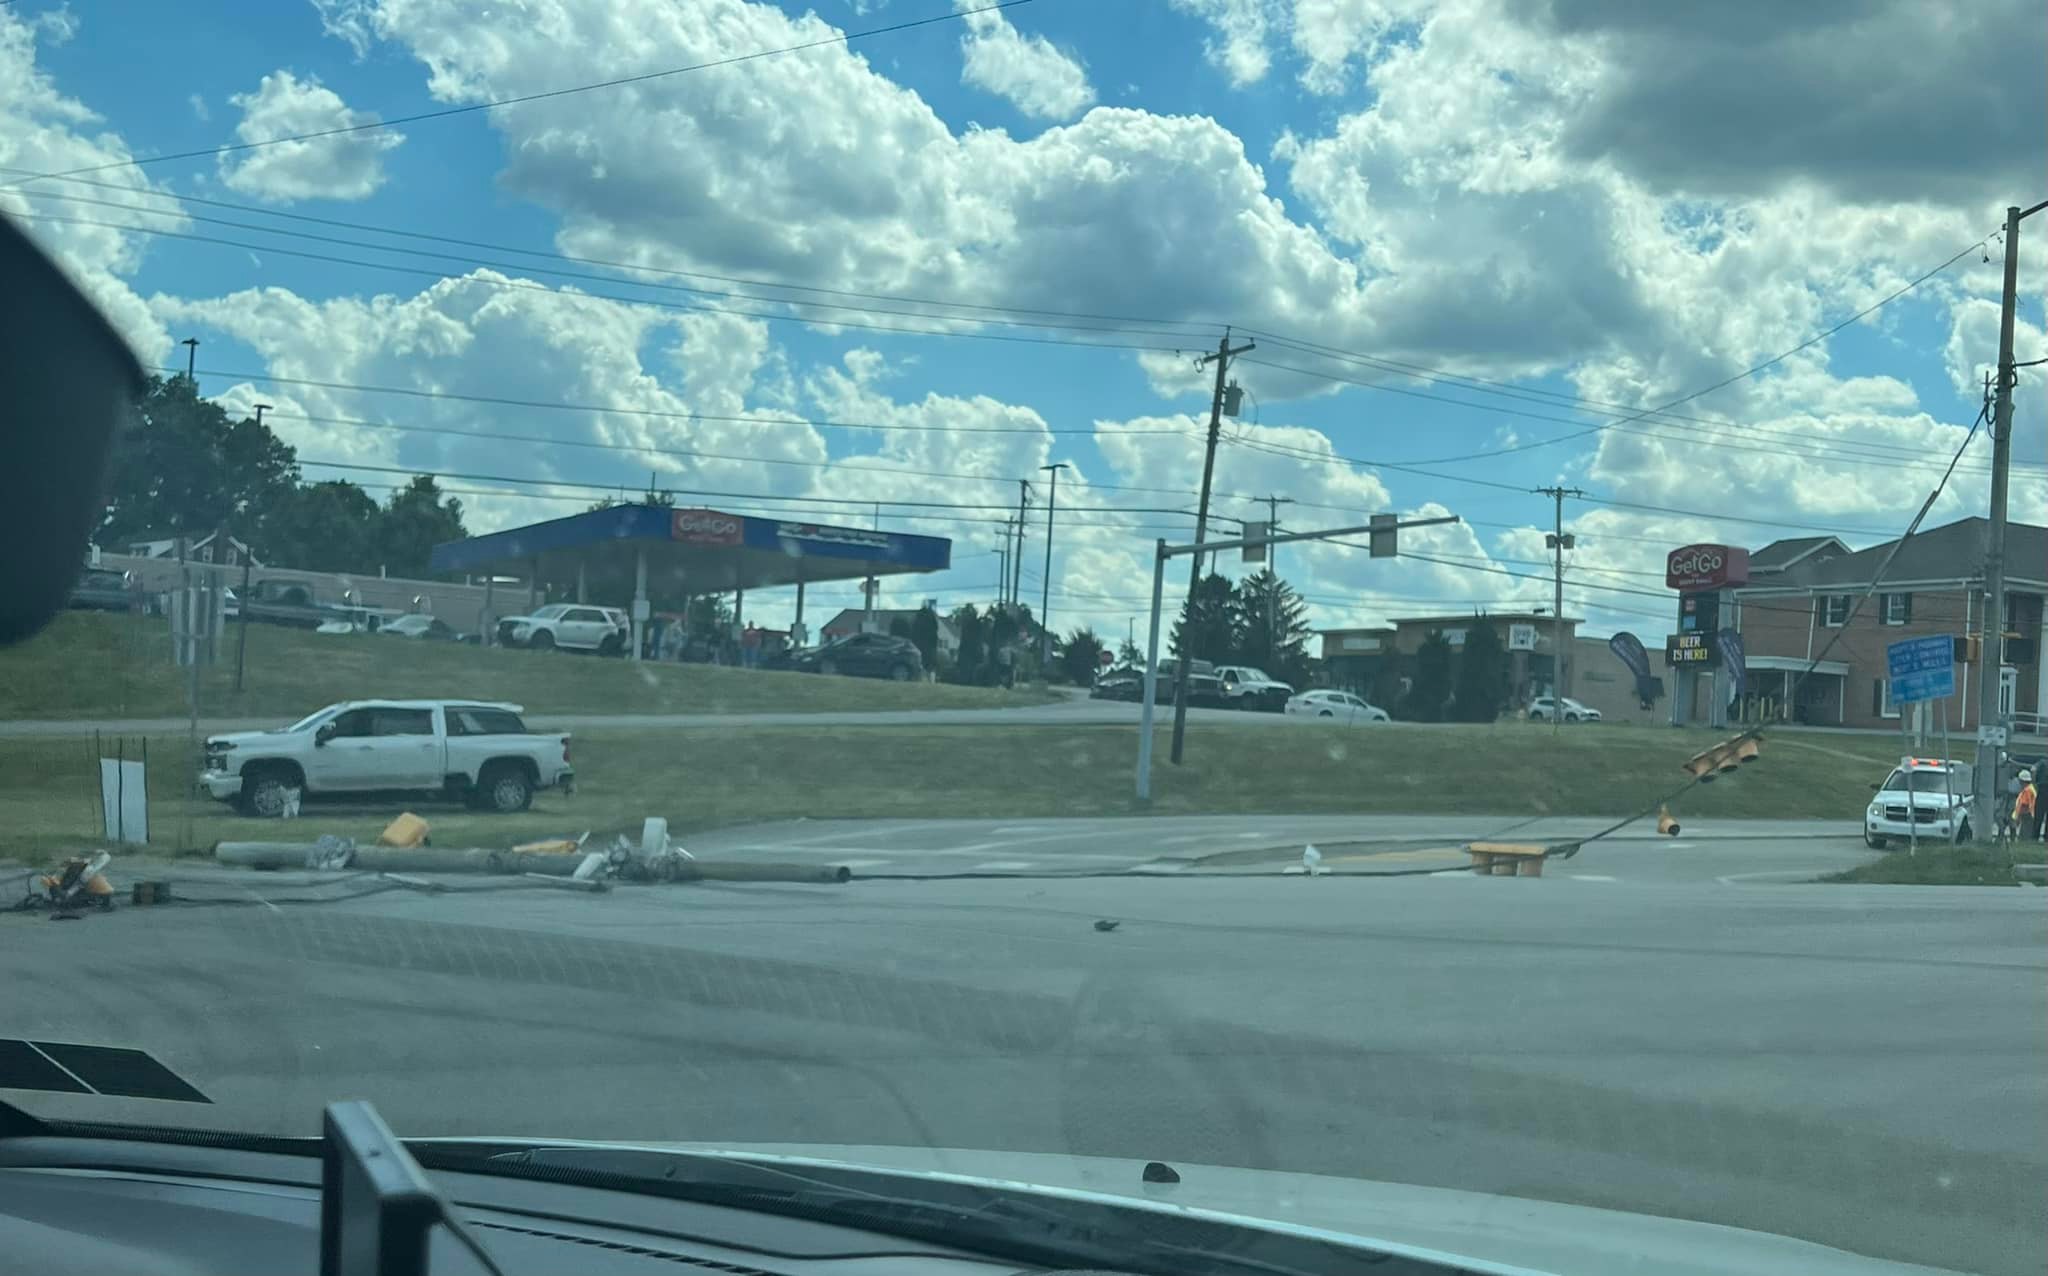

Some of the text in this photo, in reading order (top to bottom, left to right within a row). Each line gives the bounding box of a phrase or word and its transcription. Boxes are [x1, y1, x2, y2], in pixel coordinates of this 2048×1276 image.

[1670, 552, 1722, 575] GetGo
[1679, 635, 1701, 648] BEER
[1672, 647, 1708, 661] IS HERE!
